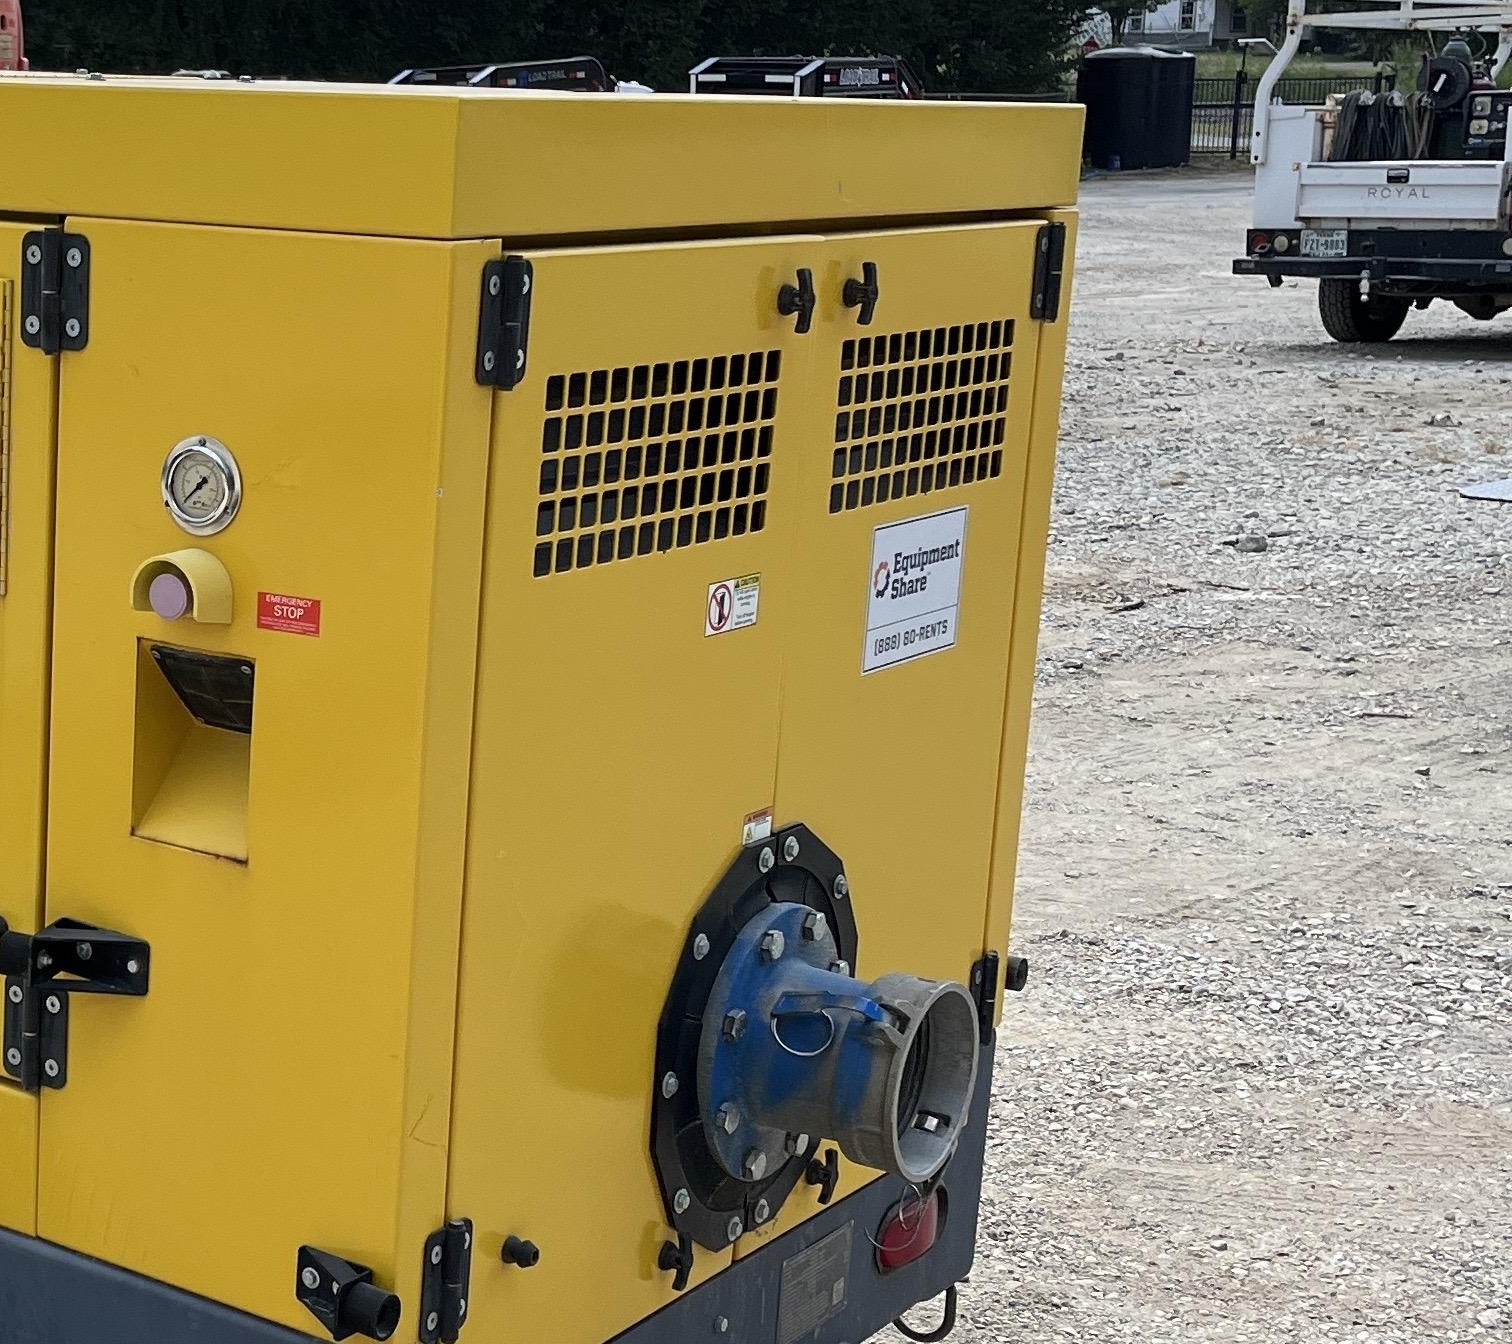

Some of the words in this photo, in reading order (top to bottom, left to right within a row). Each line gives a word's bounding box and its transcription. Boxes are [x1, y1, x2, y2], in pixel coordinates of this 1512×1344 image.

[1367, 186, 1431, 200] ROYAL
[893, 538, 961, 577] Equipment
[890, 574, 928, 600] Share
[265, 594, 313, 608] EMERGENCY
[273, 604, 304, 620] STOP
[874, 631, 901, 656] (888)
[903, 619, 948, 647] 80-RENTS
